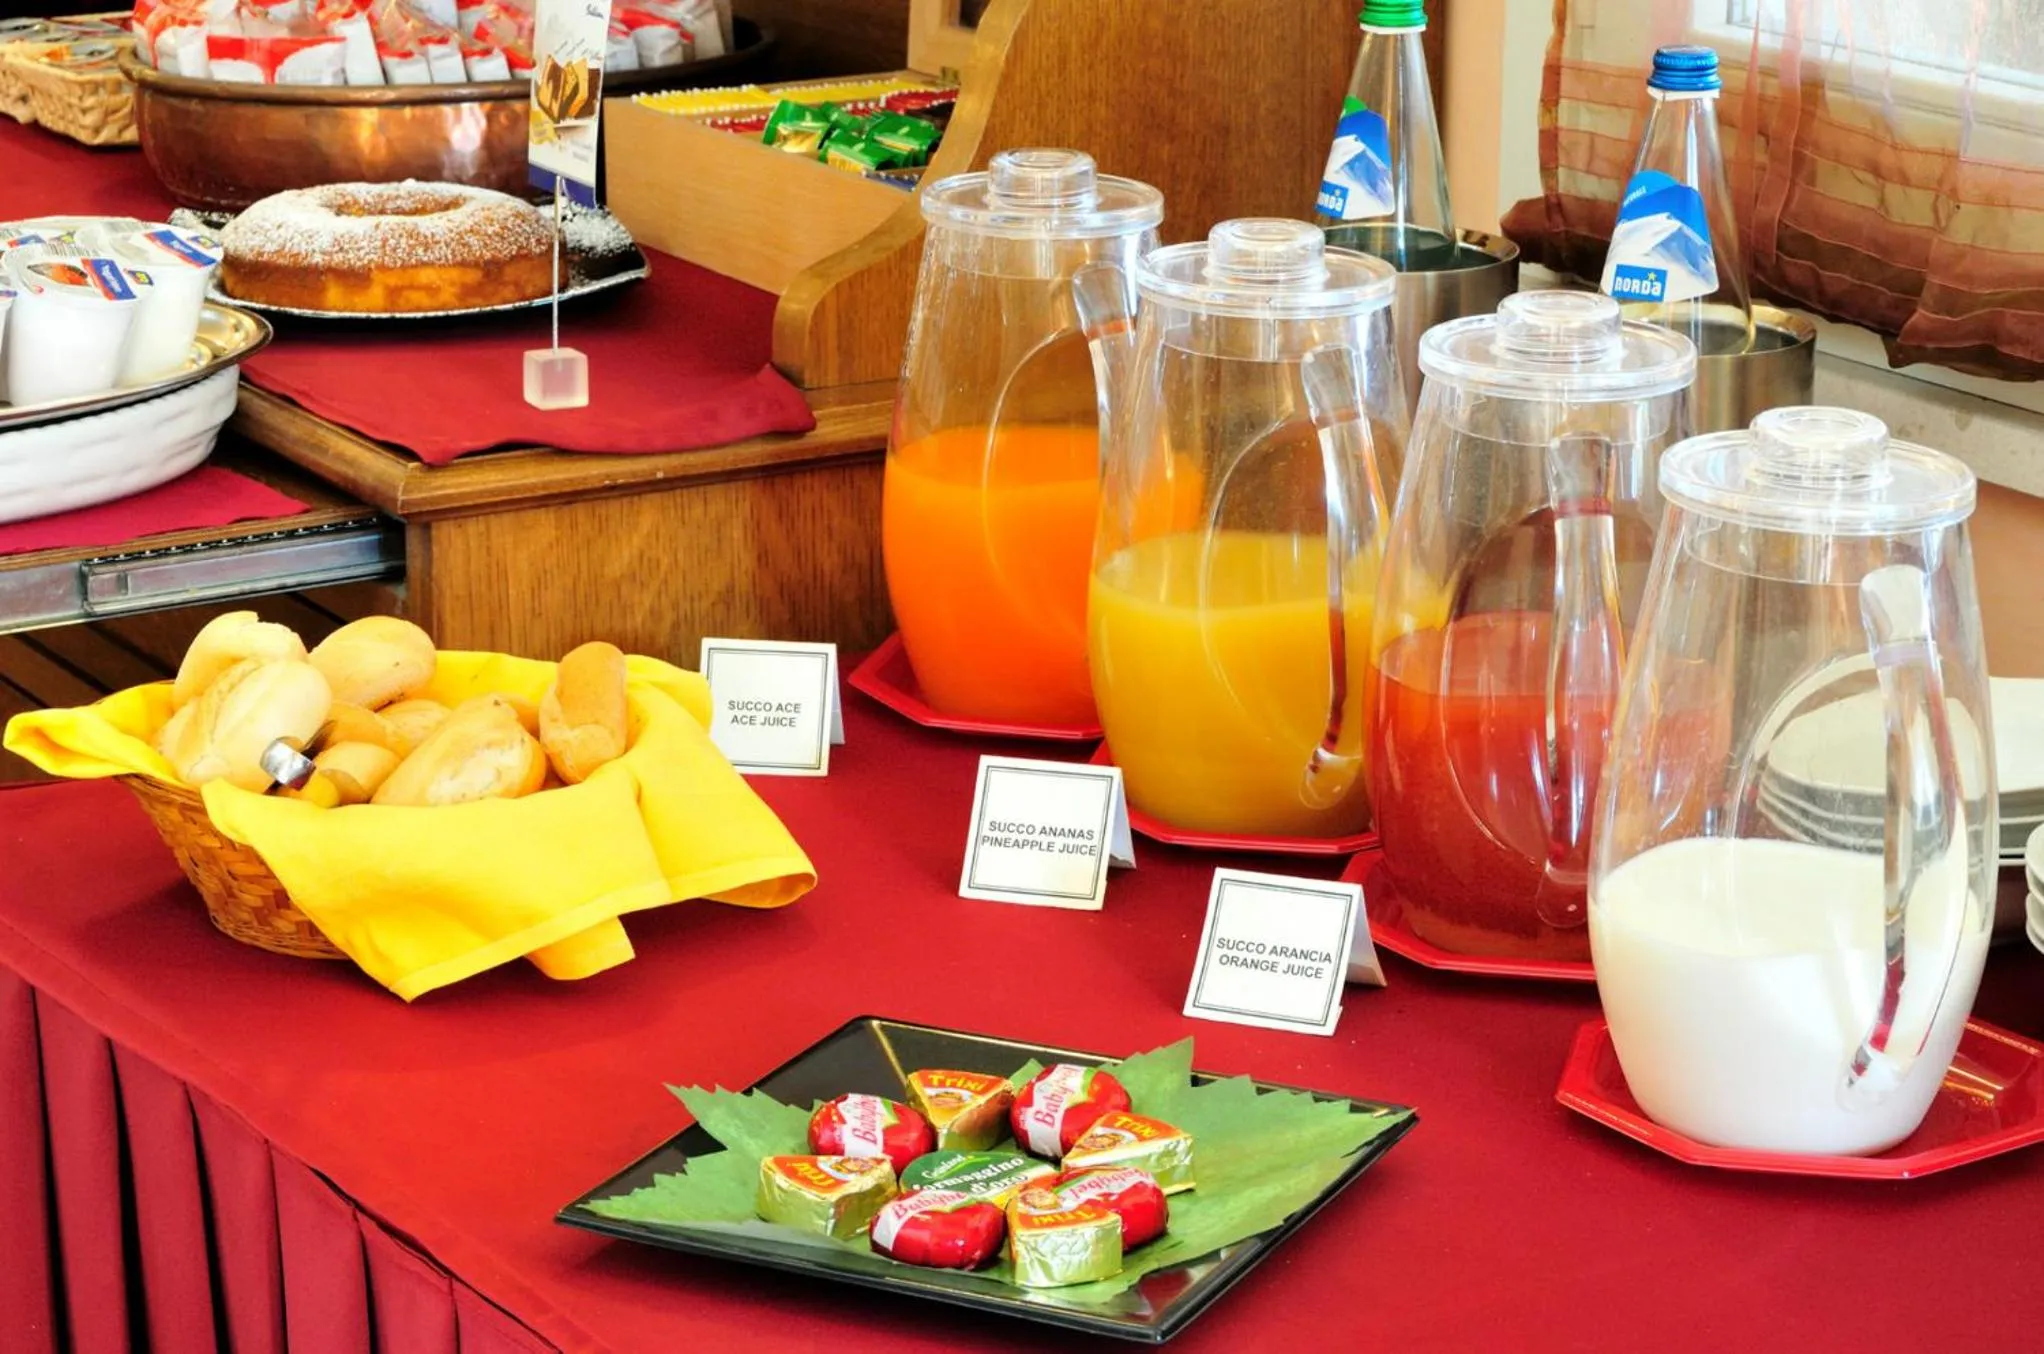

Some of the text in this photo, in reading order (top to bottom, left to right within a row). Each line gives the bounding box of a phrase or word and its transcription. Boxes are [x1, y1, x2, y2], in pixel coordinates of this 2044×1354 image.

[728, 700, 801, 713] SUCCO ACE
[731, 714, 796, 727] ACE JUICE
[988, 820, 1095, 841] SUCCO ANANAS
[981, 835, 1097, 856] PINEAPPLE JUICE
[1216, 937, 1332, 964] SUCCO ARANCIA
[1219, 954, 1324, 979] ORANGE JUICE
